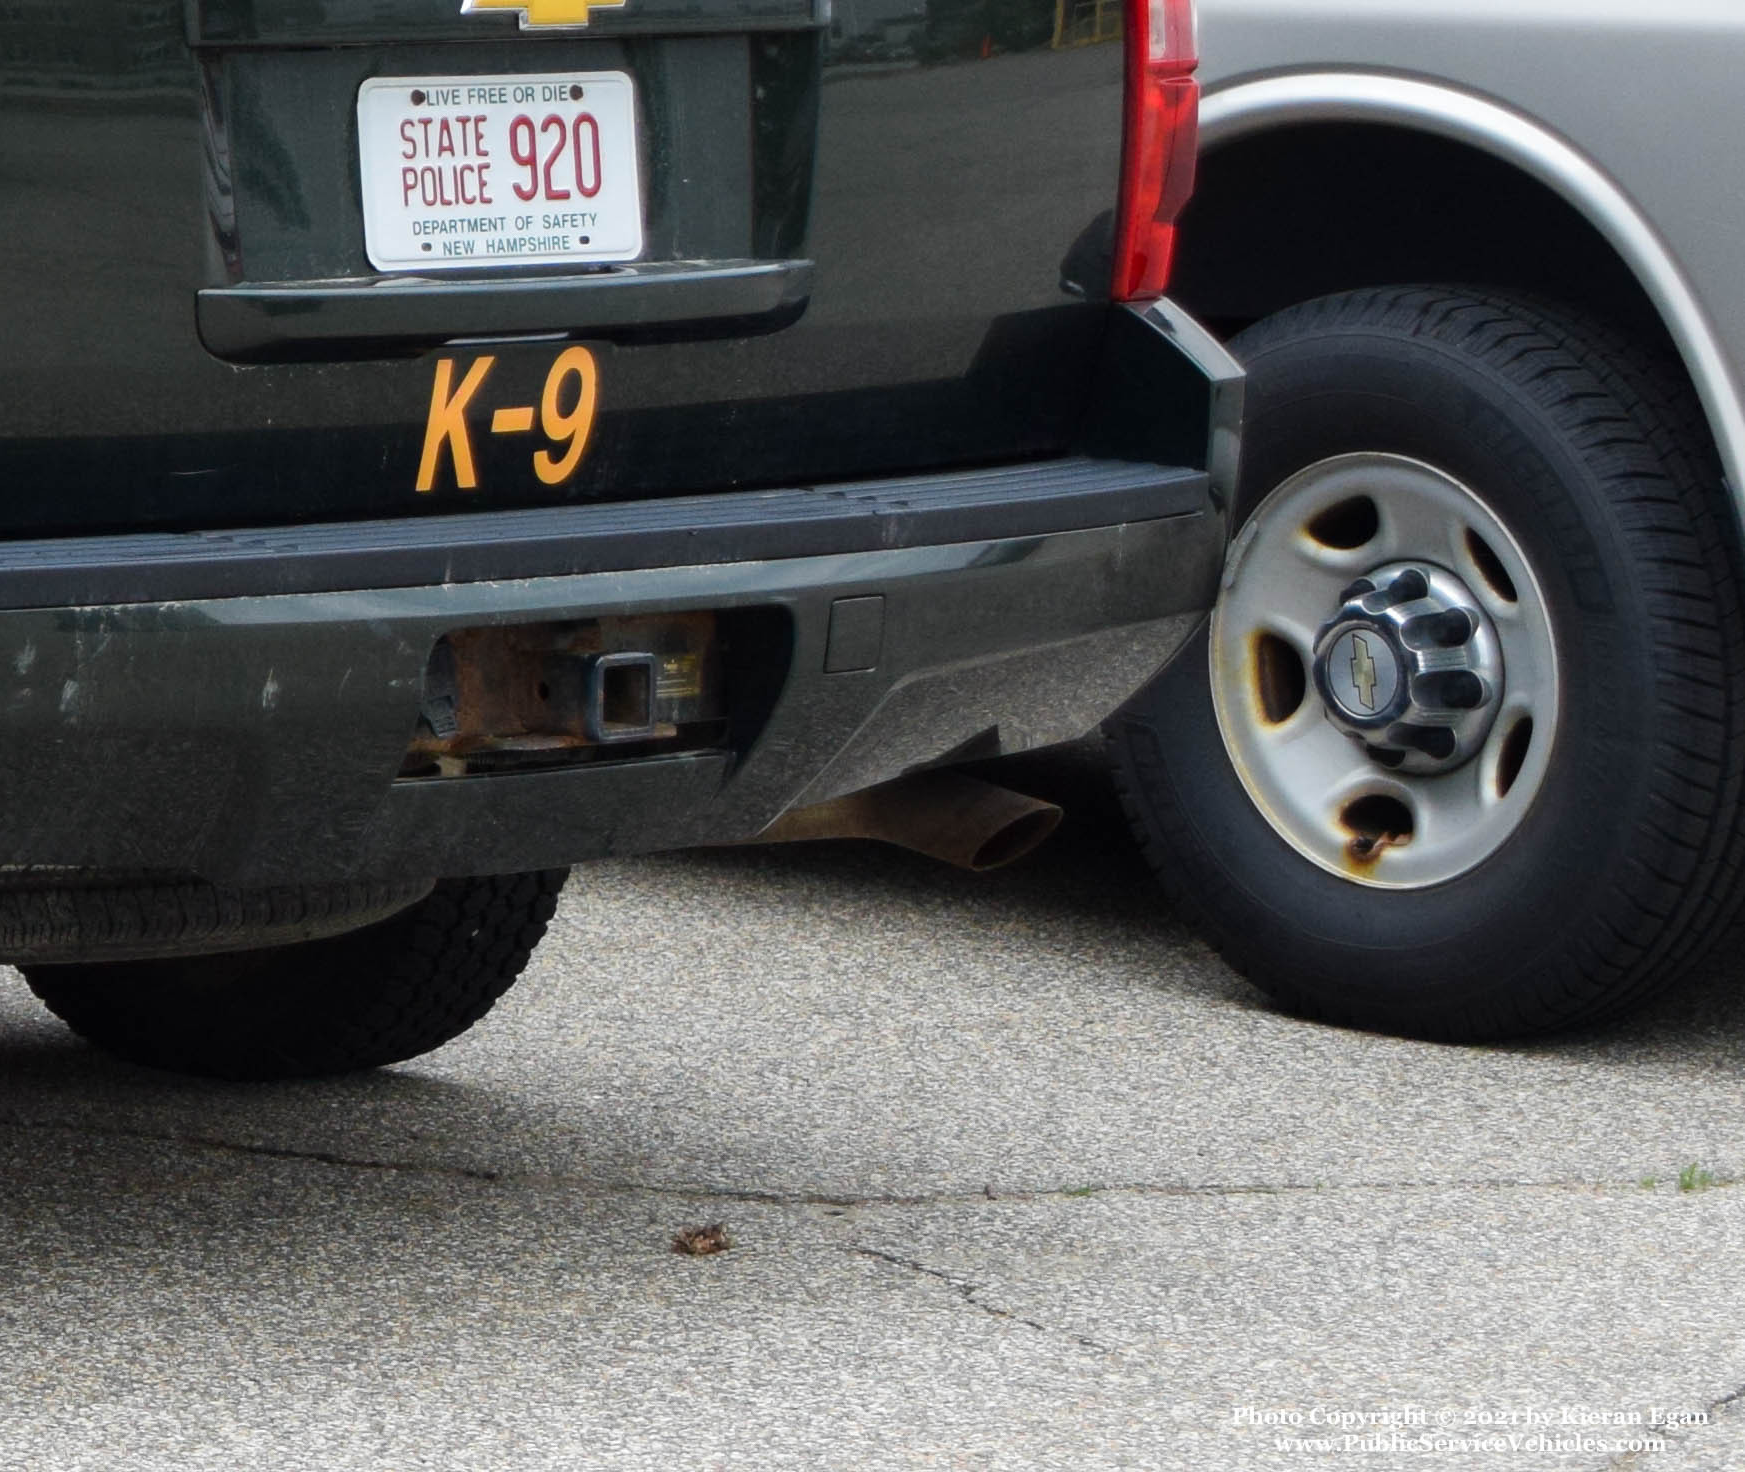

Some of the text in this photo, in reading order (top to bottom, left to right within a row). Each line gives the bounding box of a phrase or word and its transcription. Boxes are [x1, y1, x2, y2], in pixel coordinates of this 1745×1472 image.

[426, 85, 568, 106] LIVE FREE OR DIE
[400, 114, 489, 159] STATE
[509, 112, 602, 202] 920
[402, 162, 493, 207] POLICE
[412, 213, 598, 236] DEPARTMENT OF SAFETY
[442, 235, 570, 257] NEW HAMPSHIRE
[415, 345, 596, 492] K-9
